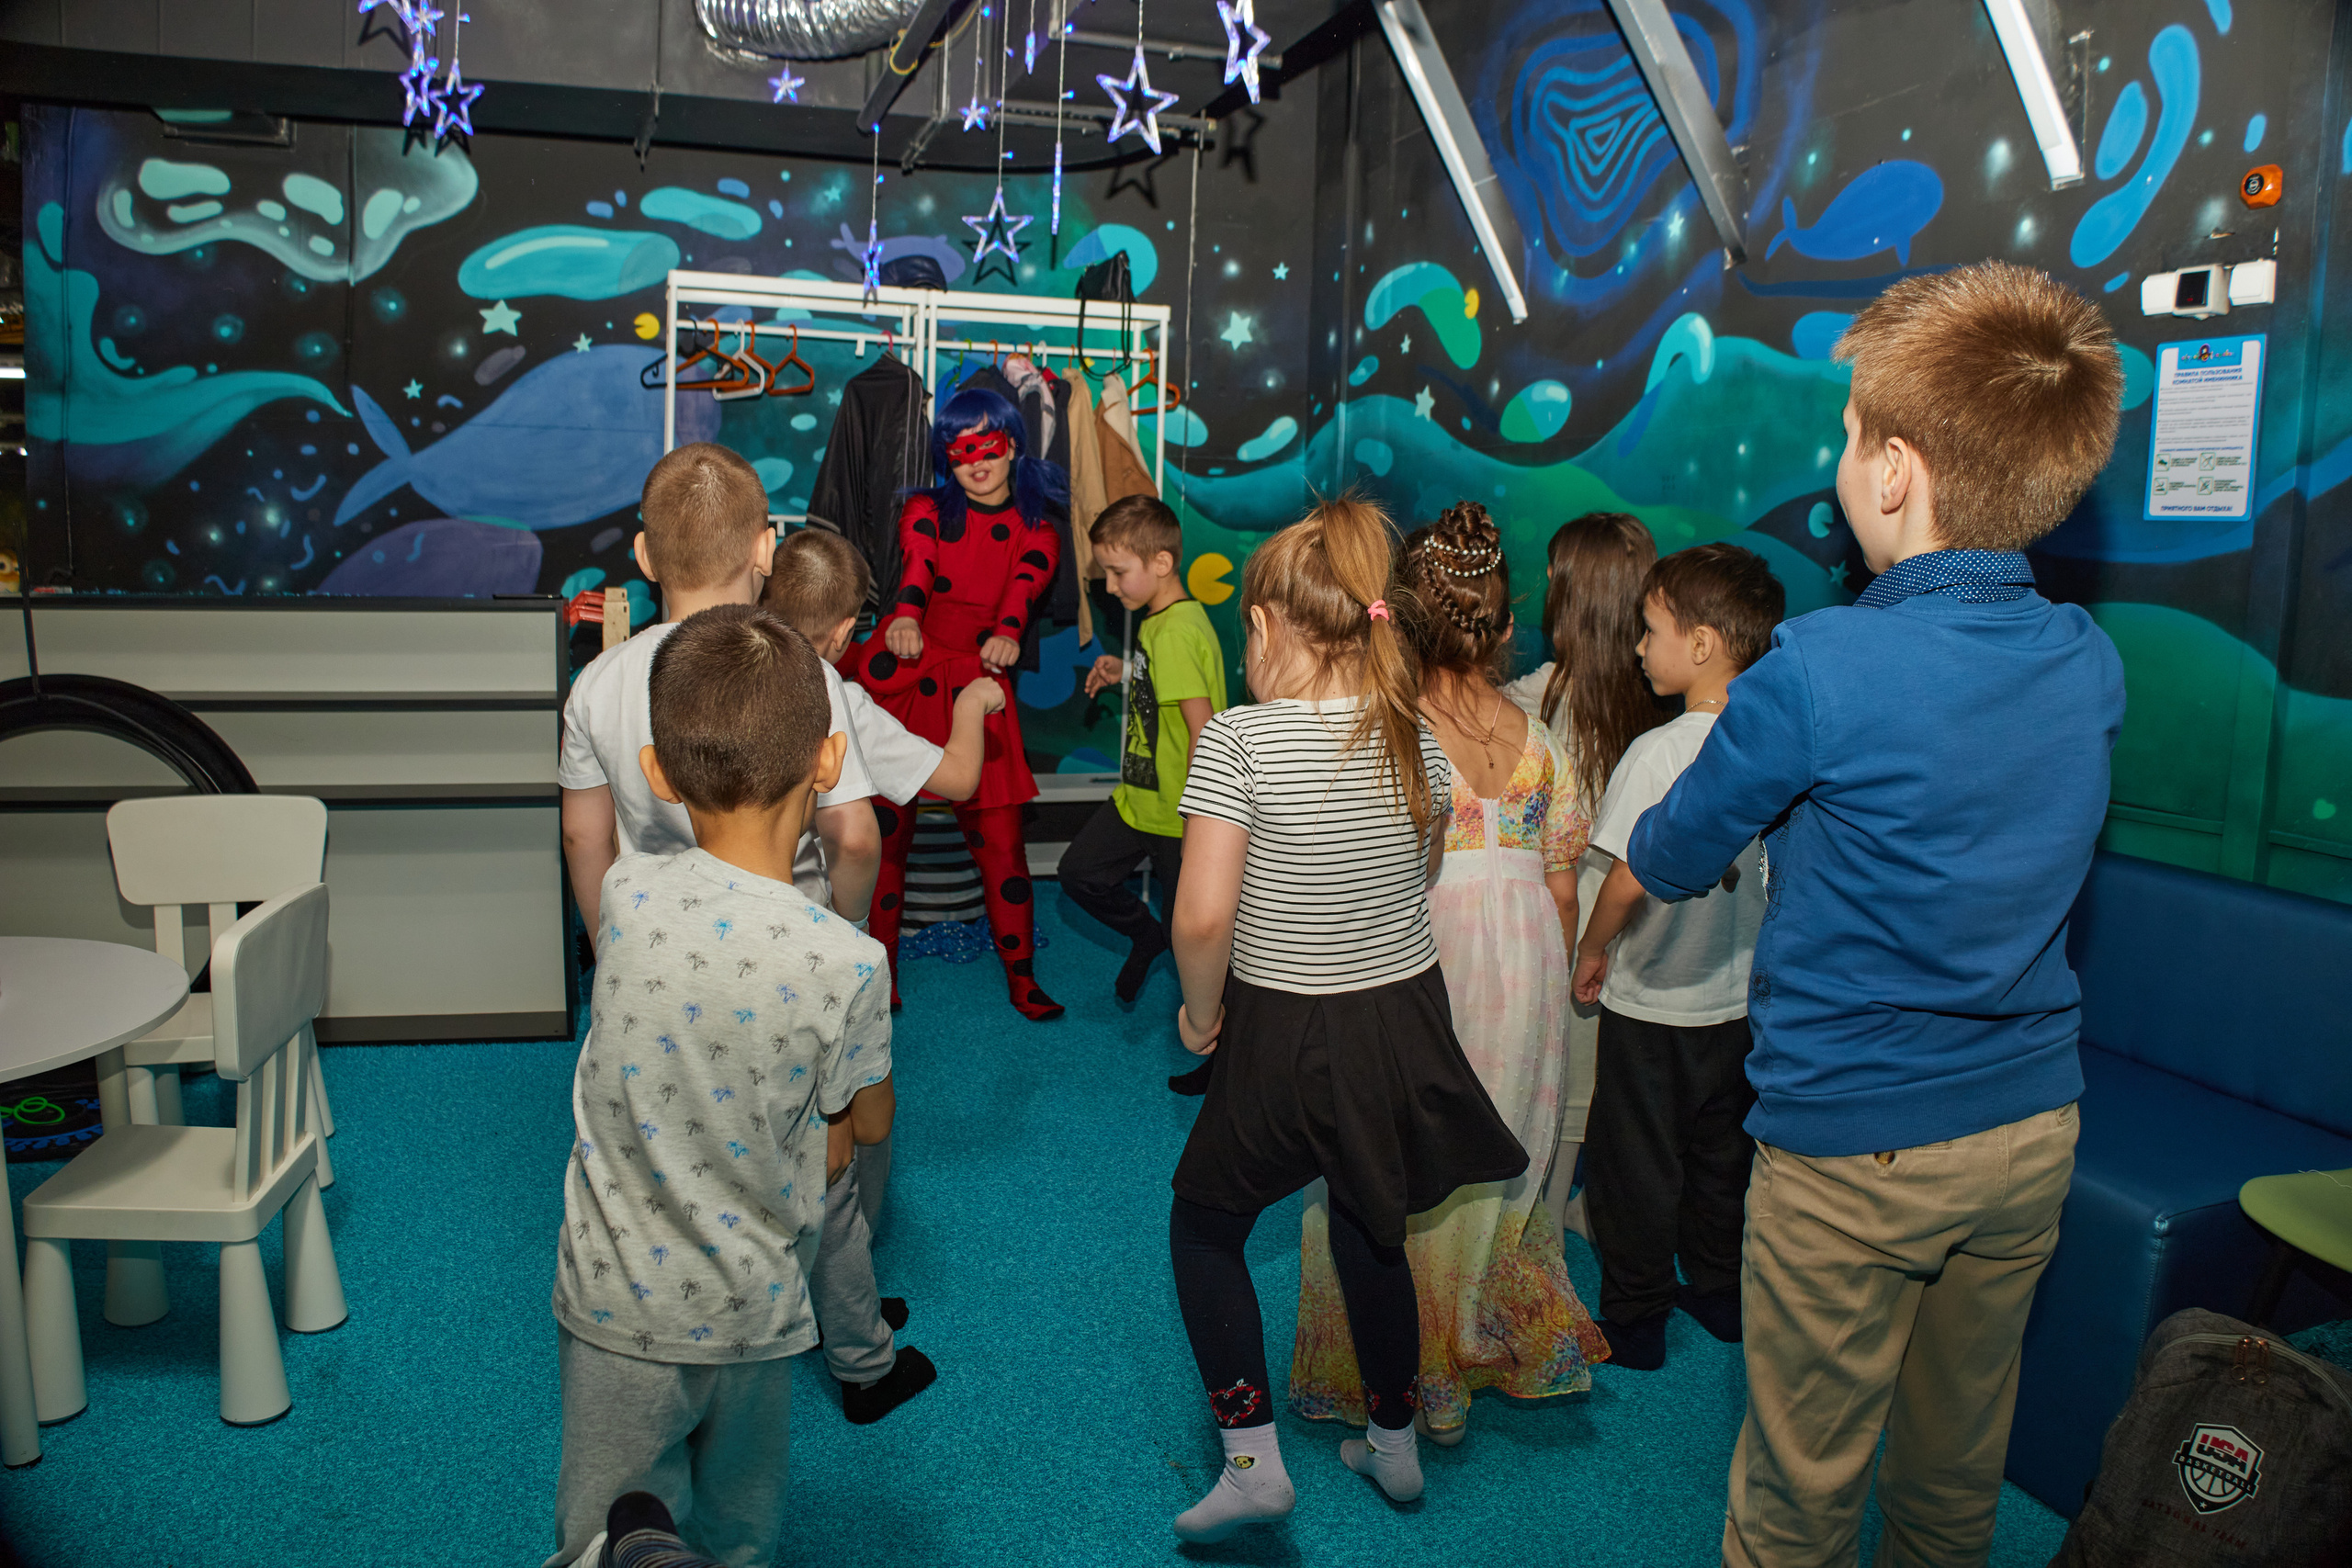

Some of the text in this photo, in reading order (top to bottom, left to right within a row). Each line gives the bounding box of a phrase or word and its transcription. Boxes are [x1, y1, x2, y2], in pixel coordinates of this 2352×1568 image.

[2172, 376, 2203, 385] КОМНАТОЙ
[2200, 367, 2242, 376] ПОЛЬЗОВАНИЯ
[2196, 1433, 2249, 1474] USA
[2178, 1455, 2252, 1492] BASKETBALL
